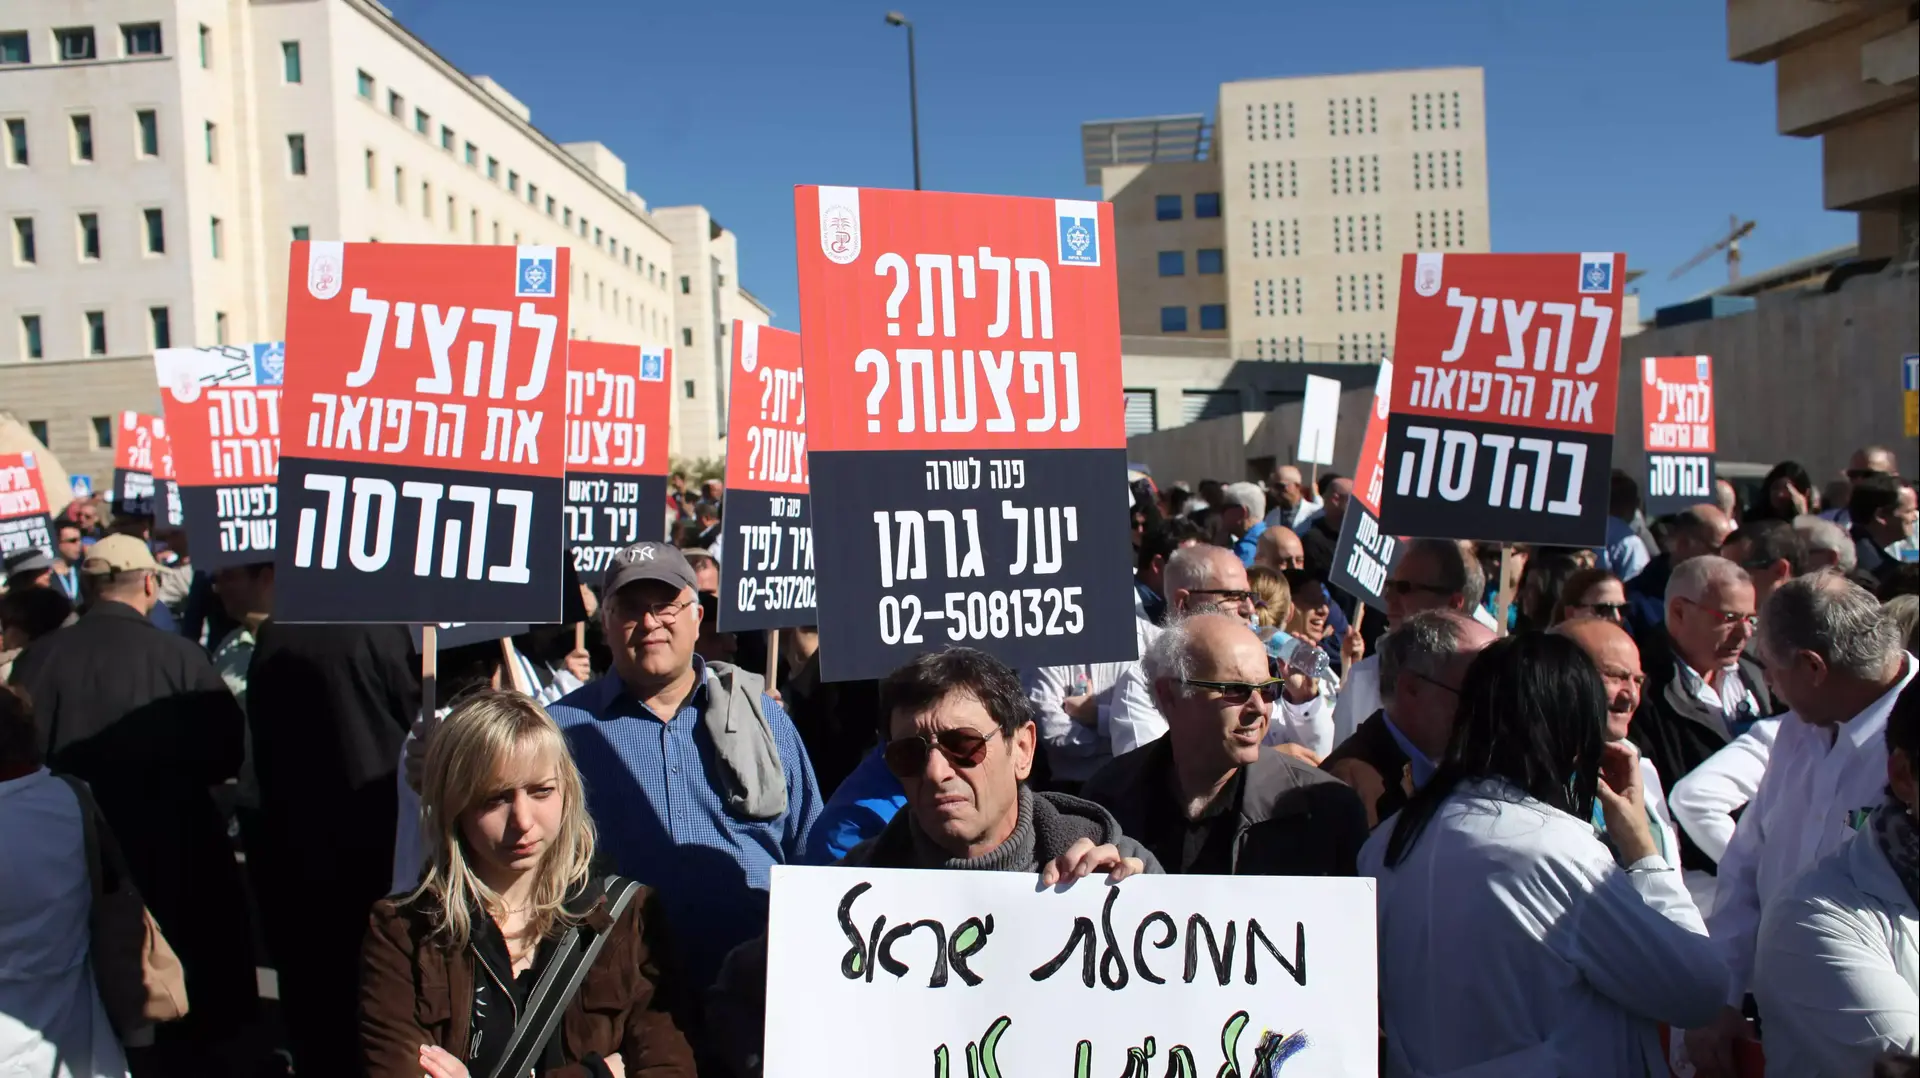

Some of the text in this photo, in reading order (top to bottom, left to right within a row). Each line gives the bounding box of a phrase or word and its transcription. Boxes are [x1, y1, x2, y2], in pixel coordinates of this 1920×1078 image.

[874, 247, 1054, 340] חלית?
[345, 287, 558, 401] להציל
[1441, 286, 1613, 376] להציל
[207, 389, 283, 437] דסה
[567, 368, 636, 419] חלית
[759, 366, 806, 426] לית?
[855, 348, 1081, 433] נפצעת?
[1409, 366, 1599, 424] את הרפואה
[1656, 377, 1710, 424] להציל
[306, 392, 543, 465] את הרפואה
[567, 420, 646, 467] נפצע
[746, 425, 809, 485] צעת?
[568, 479, 639, 503] פנה לראש
[926, 456, 1025, 491] פנה לשרה
[1397, 426, 1589, 517] בהדסה
[1650, 455, 1710, 496] בהדסה
[216, 484, 277, 518] לפנות
[295, 474, 533, 583] בהדסה
[564, 506, 638, 542] ניר בר
[571, 546, 624, 572] 2977
[739, 521, 815, 571] איר לפיד
[874, 500, 1078, 587] יעל גרמן
[738, 575, 817, 612] 02-5317202
[879, 586, 1084, 645] 02-5081325
[837, 882, 1307, 991] ממשלת ישראל
